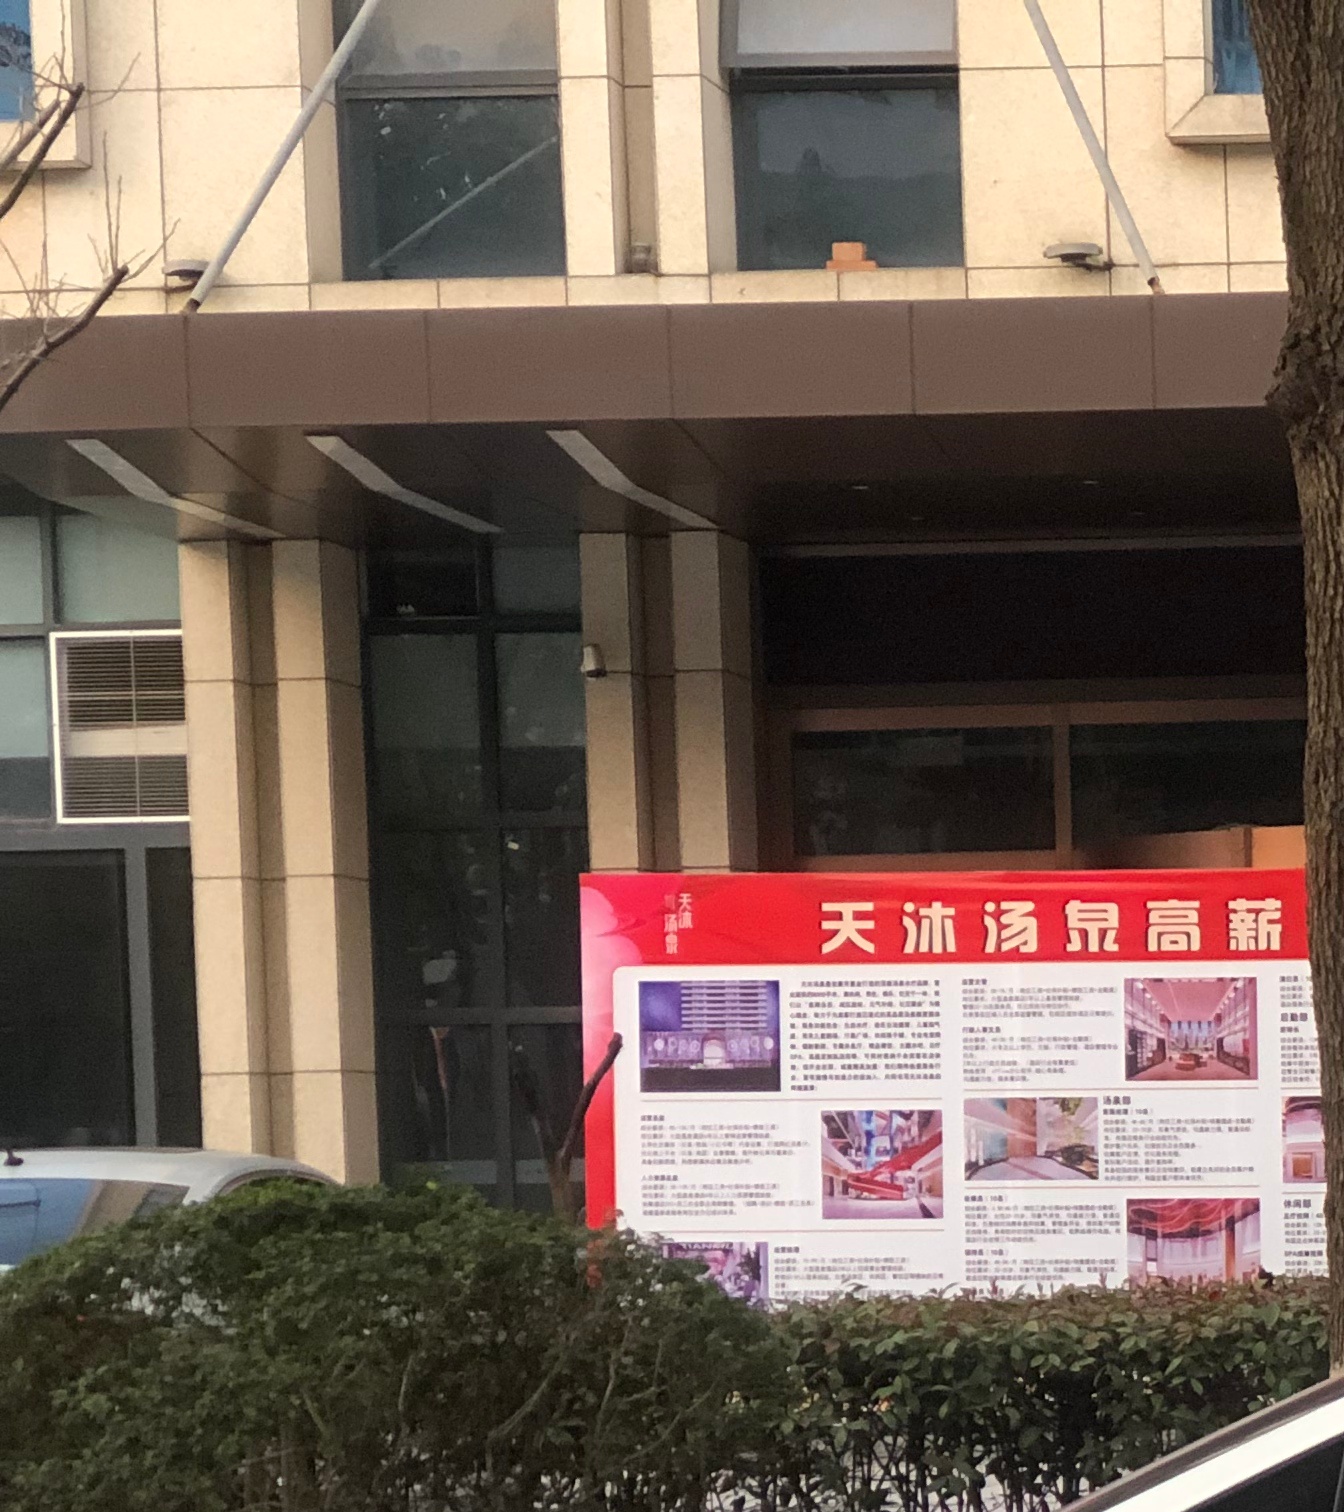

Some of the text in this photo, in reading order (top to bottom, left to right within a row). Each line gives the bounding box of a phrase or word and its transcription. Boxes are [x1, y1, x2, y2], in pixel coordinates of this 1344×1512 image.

[820, 897, 1283, 956] 天沐汤泉高薪
